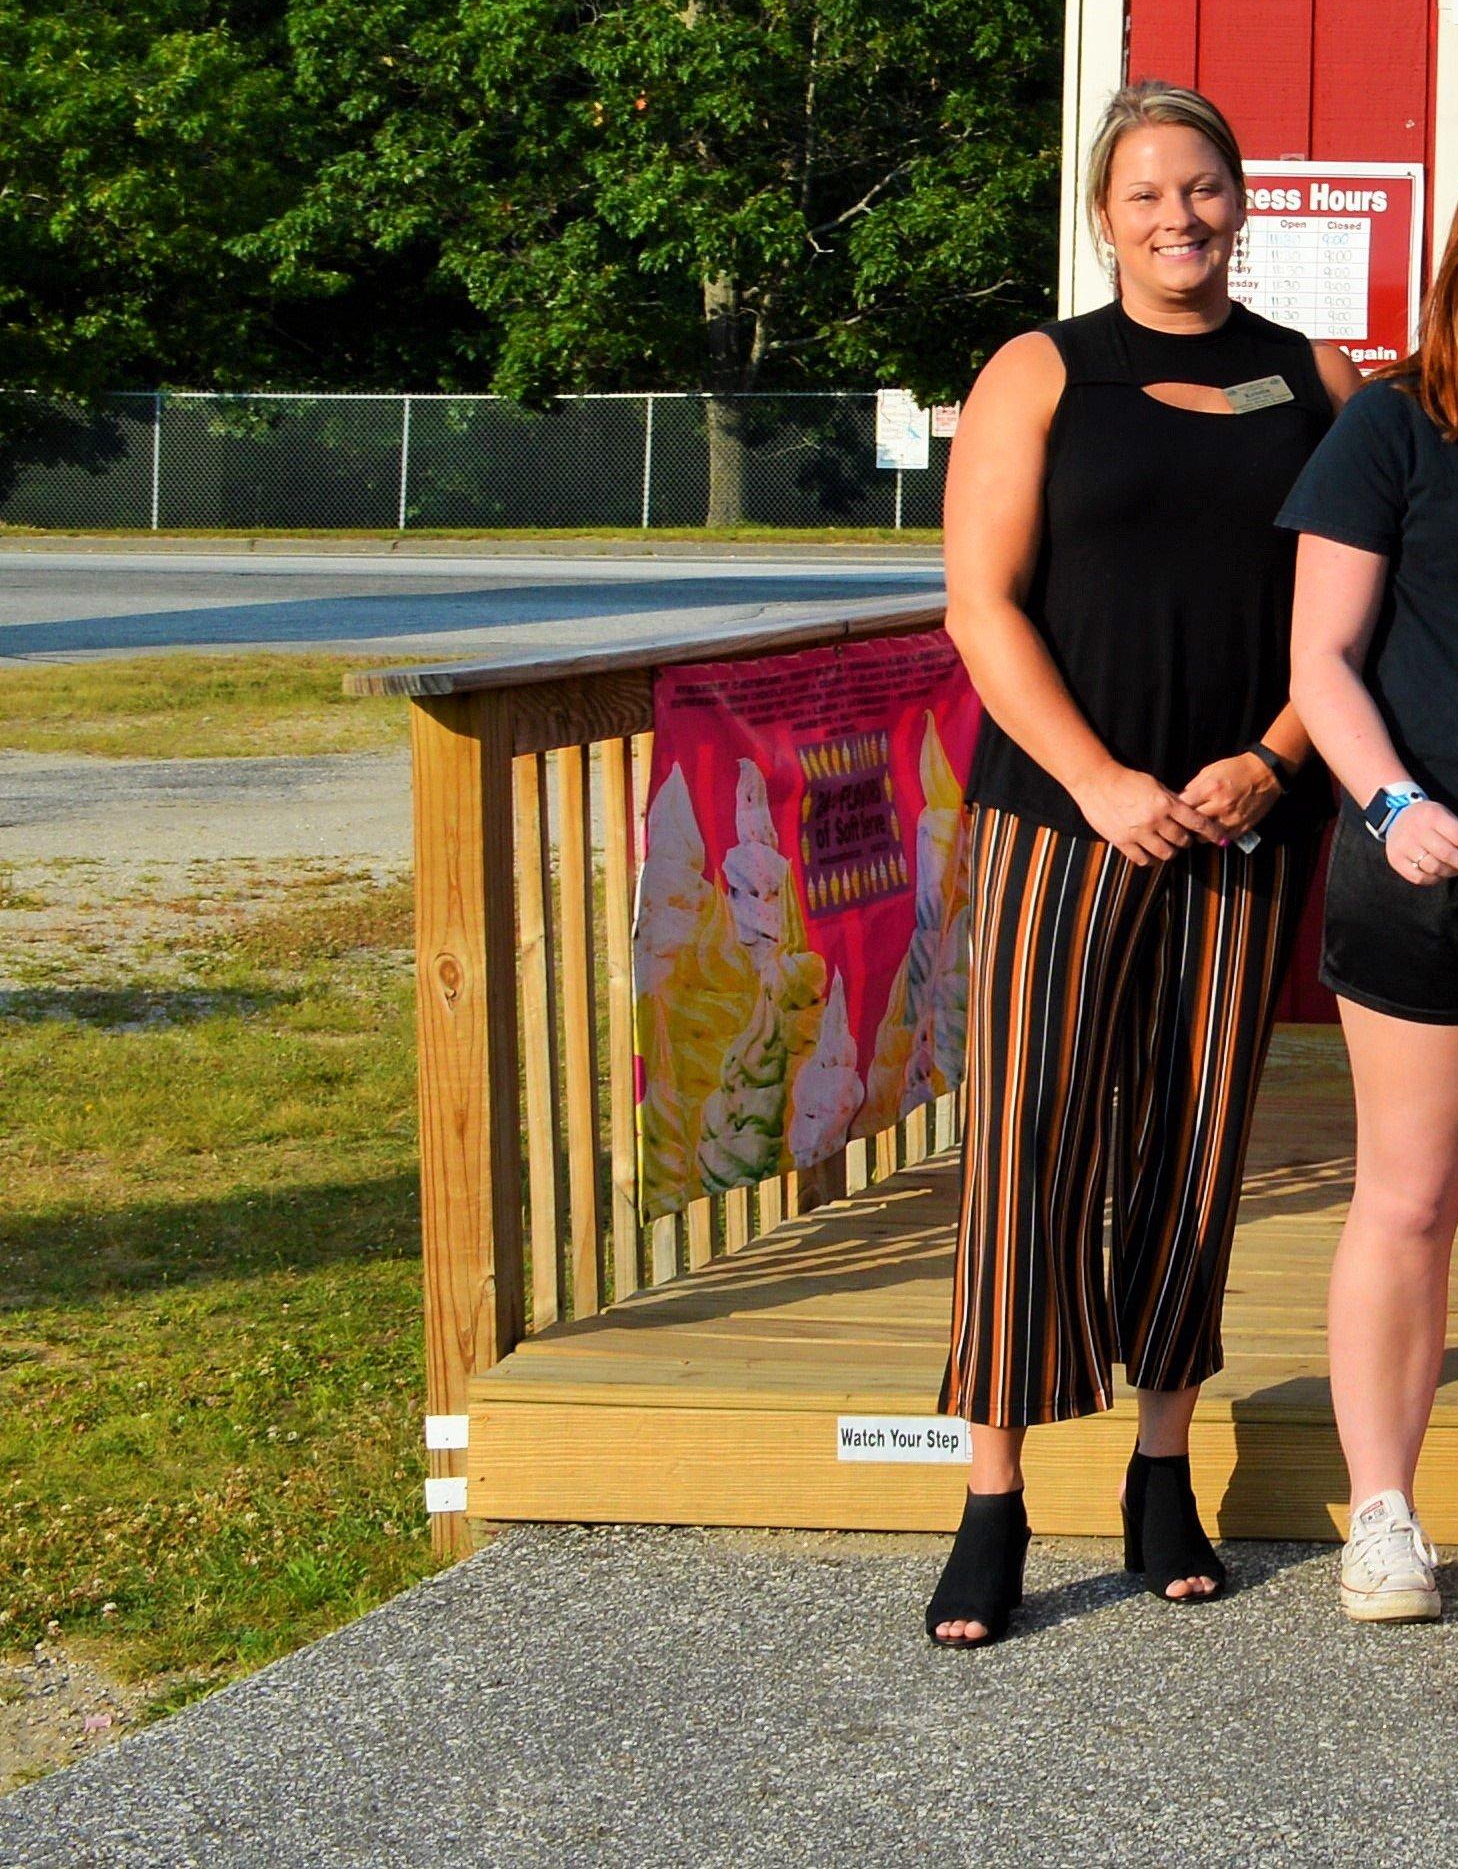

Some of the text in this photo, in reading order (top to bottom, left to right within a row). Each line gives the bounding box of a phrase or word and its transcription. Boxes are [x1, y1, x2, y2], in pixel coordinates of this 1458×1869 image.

[1309, 183, 1388, 213] Hours
[1280, 219, 1362, 231] Open Closed
[841, 1427, 960, 1454] Watch Your Step
